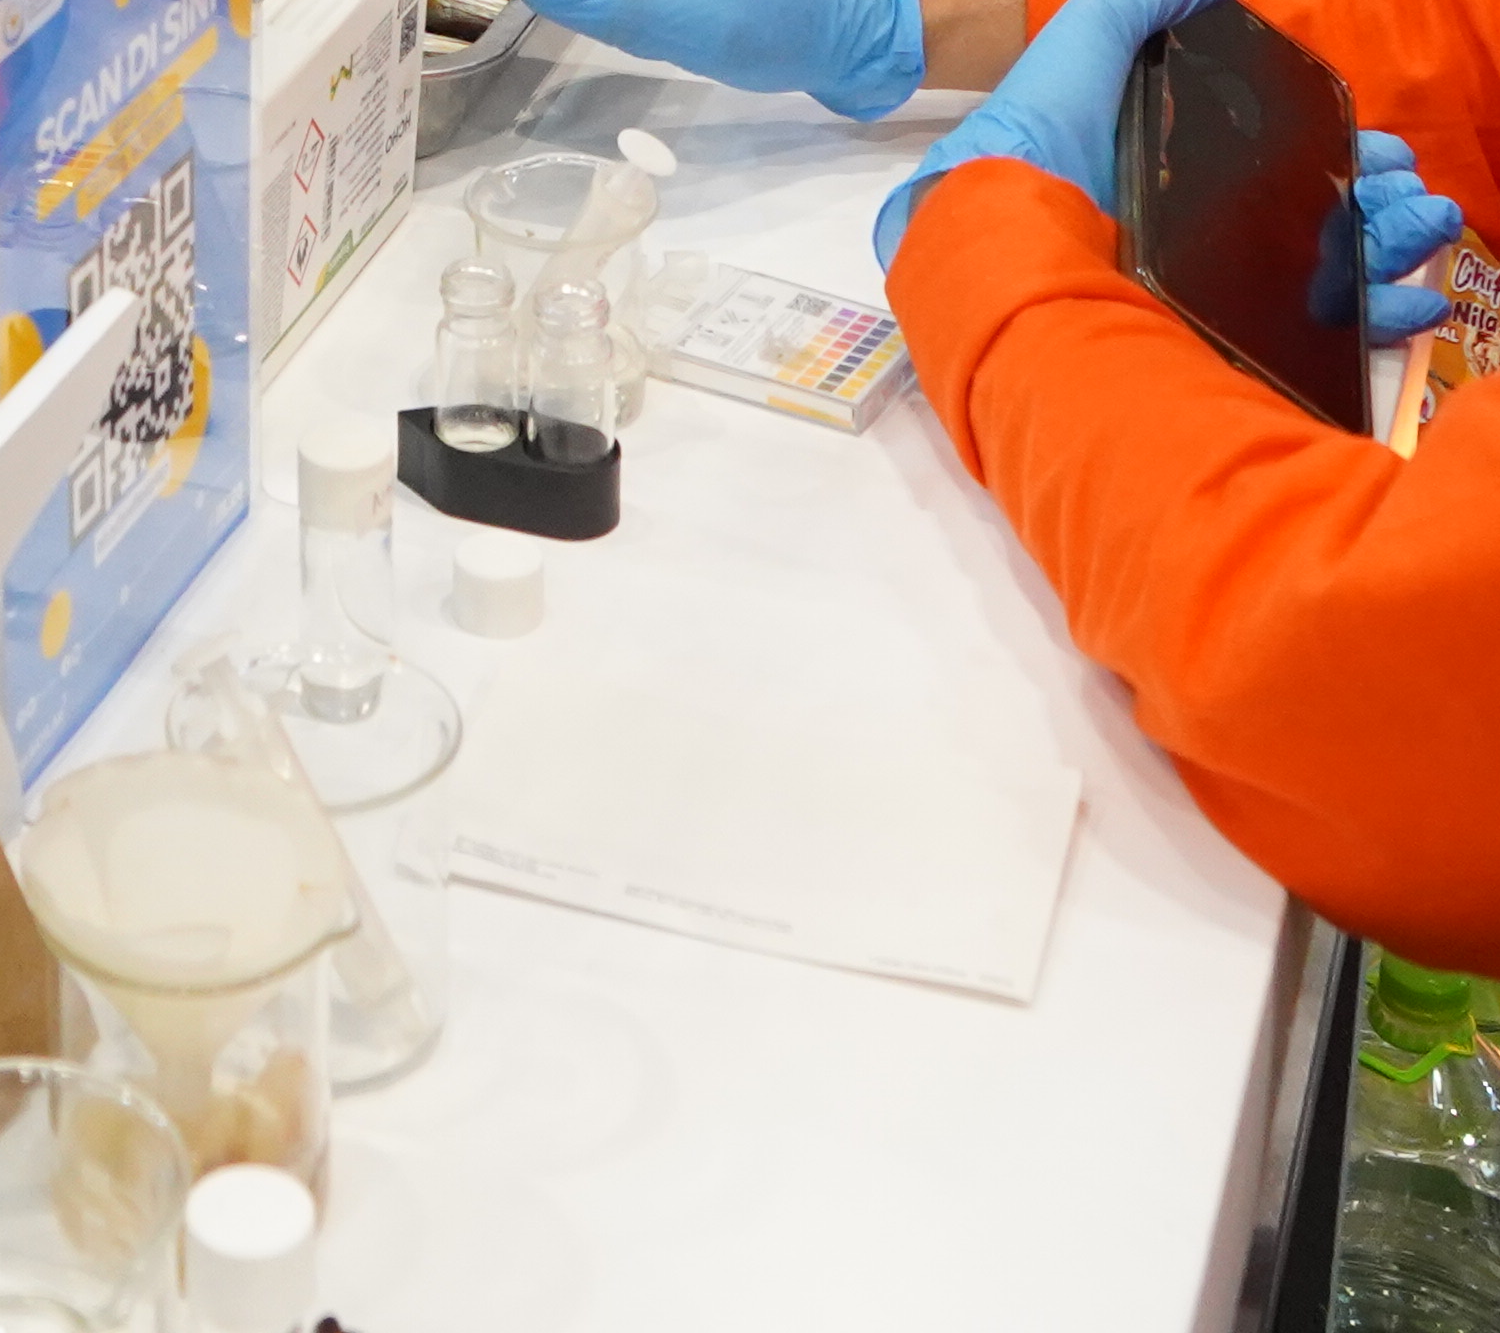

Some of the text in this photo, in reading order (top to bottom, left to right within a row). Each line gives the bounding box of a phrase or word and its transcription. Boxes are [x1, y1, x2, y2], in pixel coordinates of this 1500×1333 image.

[33, 53, 126, 174] SCAN
[127, 21, 158, 91] DI
[1453, 300, 1500, 334] Nila
